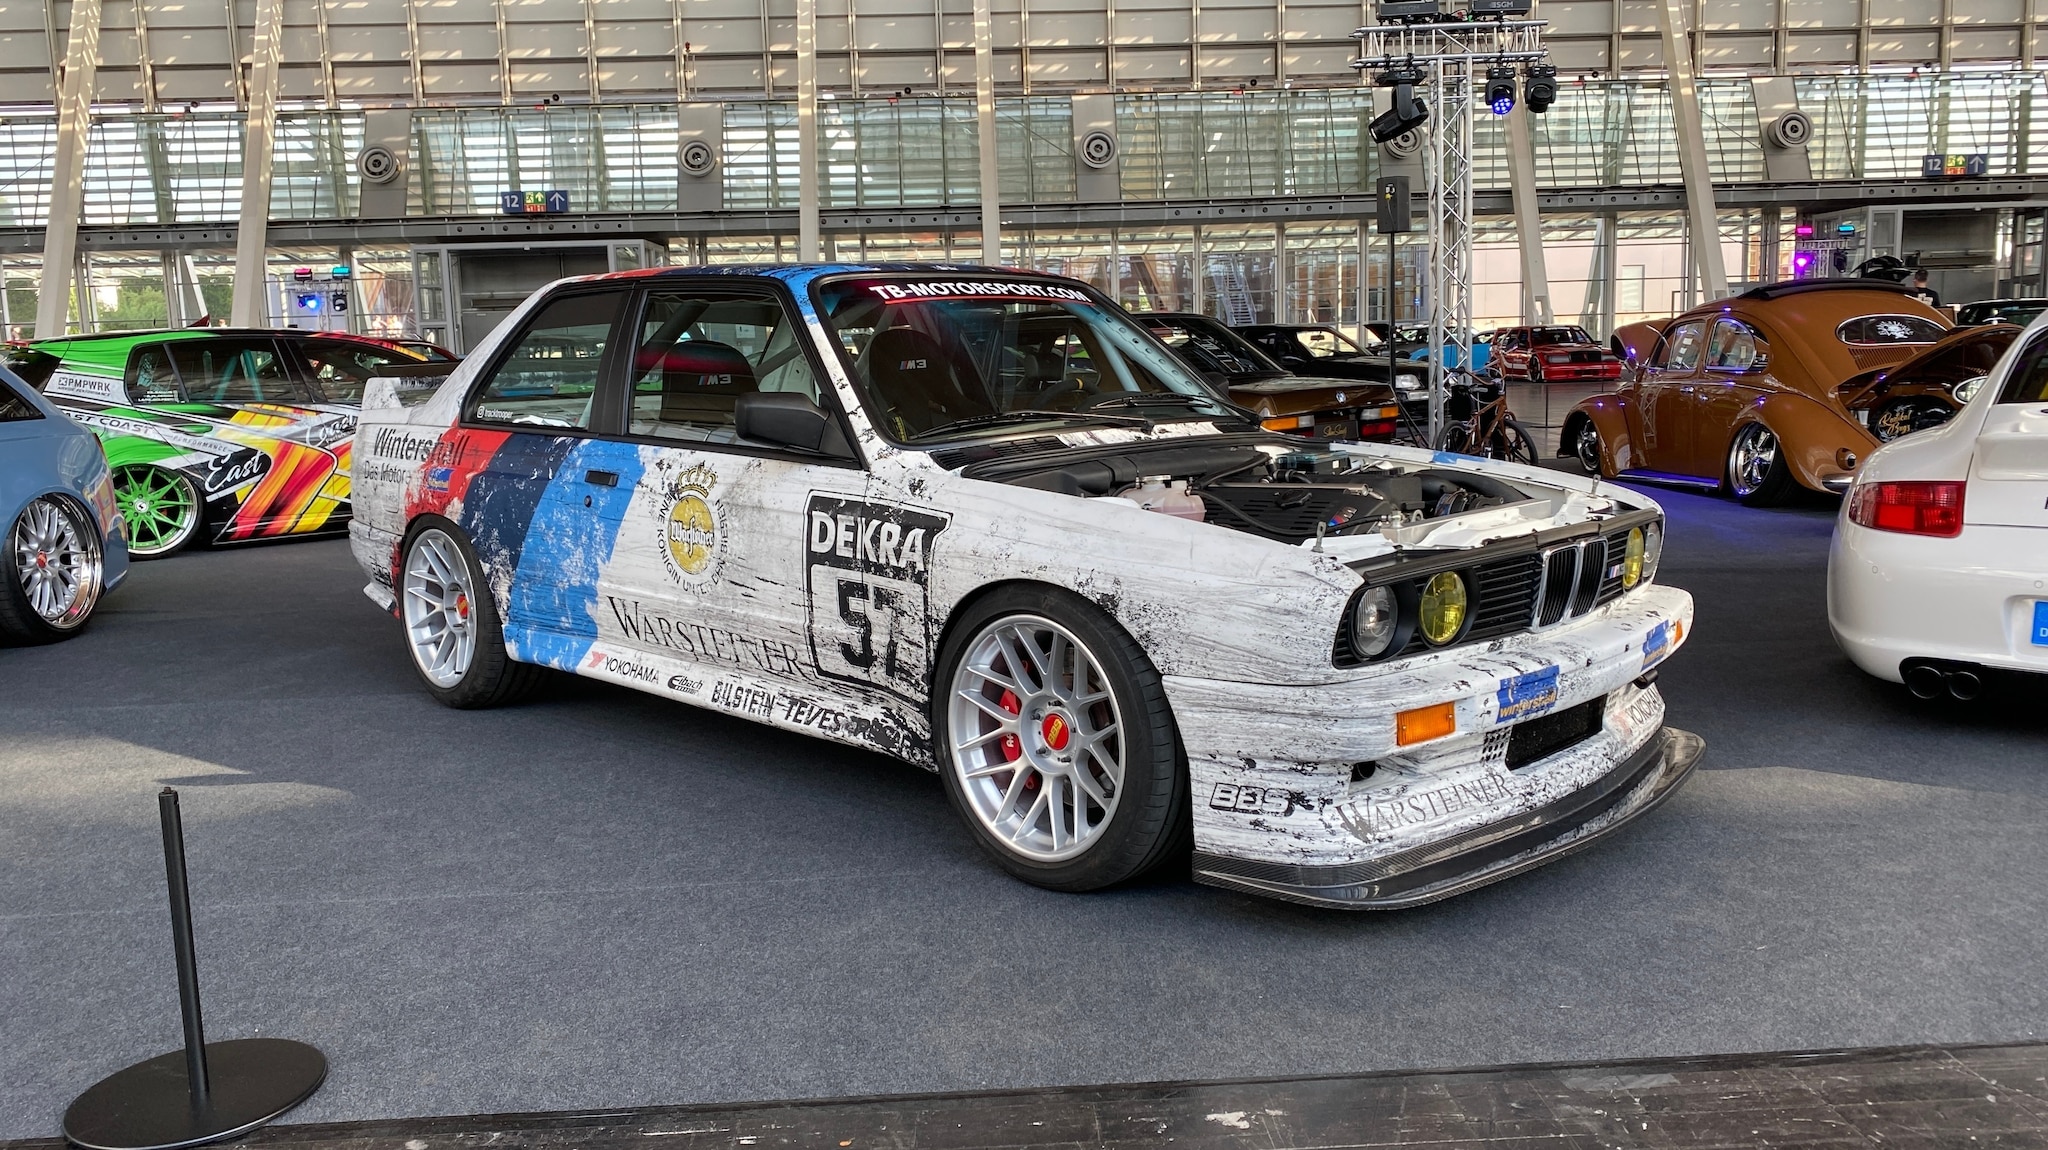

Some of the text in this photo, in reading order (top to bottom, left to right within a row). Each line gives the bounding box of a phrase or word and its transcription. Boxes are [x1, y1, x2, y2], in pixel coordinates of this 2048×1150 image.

[1928, 158, 1941, 171] 12
[504, 195, 519, 208] 12
[868, 282, 1092, 303] TB-MOTORSPORT.COM
[68, 378, 111, 392] PMPWRK
[65, 412, 154, 434] AST COAST
[172, 435, 227, 452] PERFORMANCE
[374, 427, 471, 465] Wintershall
[205, 449, 265, 492] East
[364, 460, 379, 480] Das
[811, 511, 926, 572] DEKRA
[607, 596, 811, 682] WARSTEINER
[836, 578, 902, 677] 57
[605, 656, 660, 684] YOKOHAMA
[667, 675, 704, 695] Eibach
[1208, 782, 1296, 817] BBS
[1335, 774, 1515, 844] WARSTEINER
